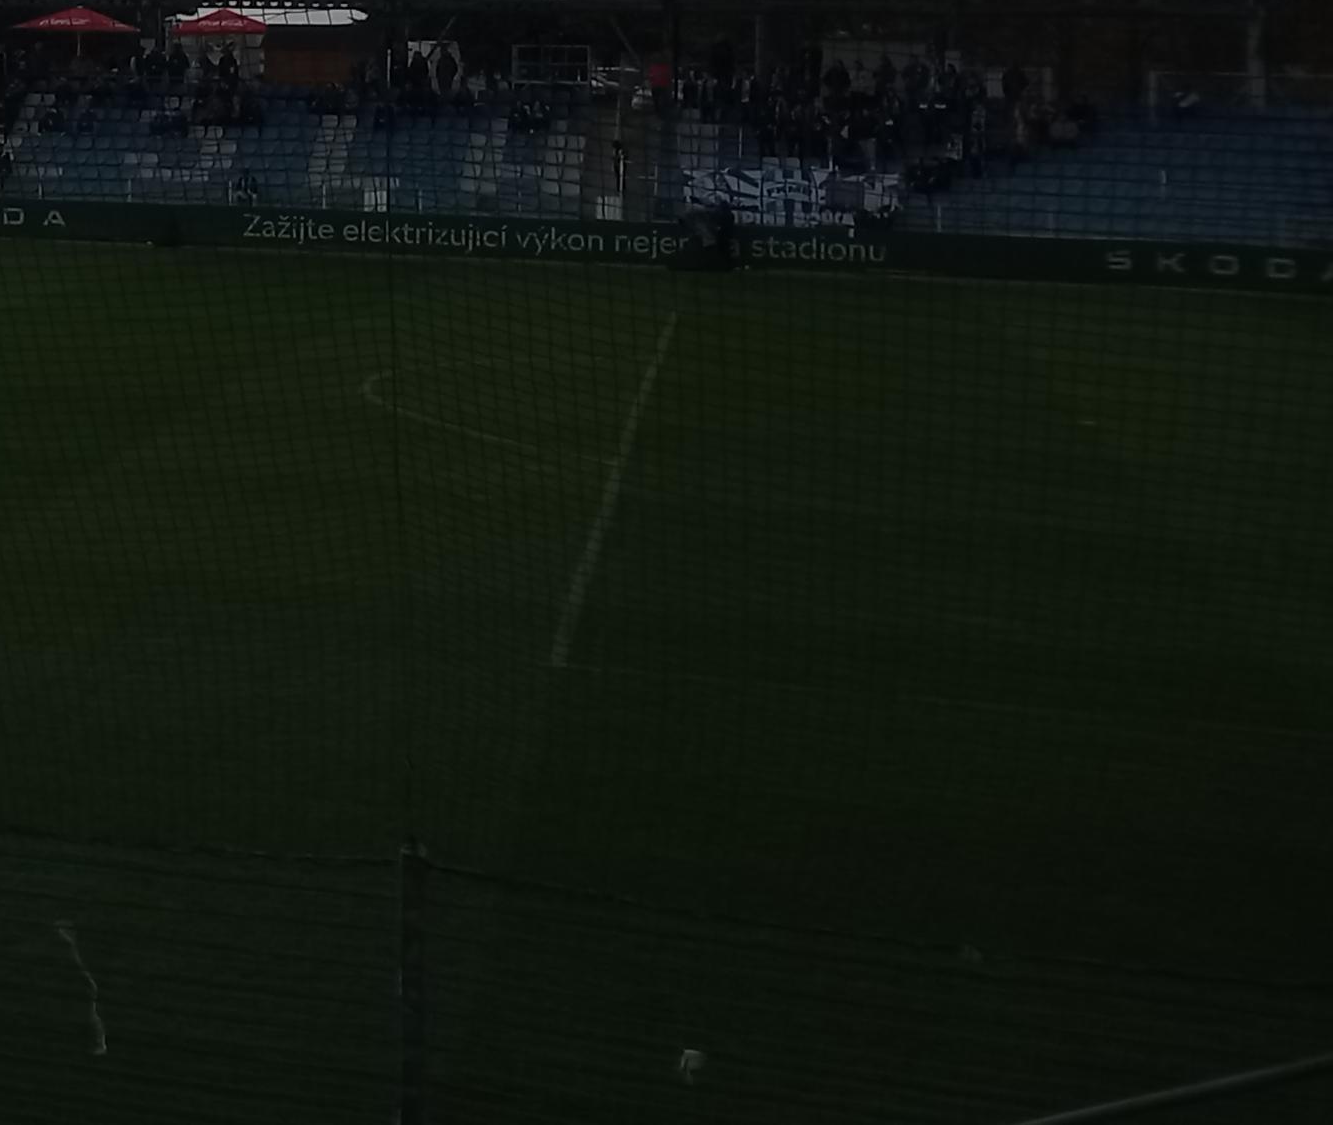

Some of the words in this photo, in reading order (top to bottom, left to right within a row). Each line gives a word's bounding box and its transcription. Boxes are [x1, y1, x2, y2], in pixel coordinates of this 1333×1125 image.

[243, 213, 334, 245] Zažijte
[342, 219, 508, 254] elektrizující
[517, 225, 605, 257] výkon
[750, 235, 889, 264] stadionu
